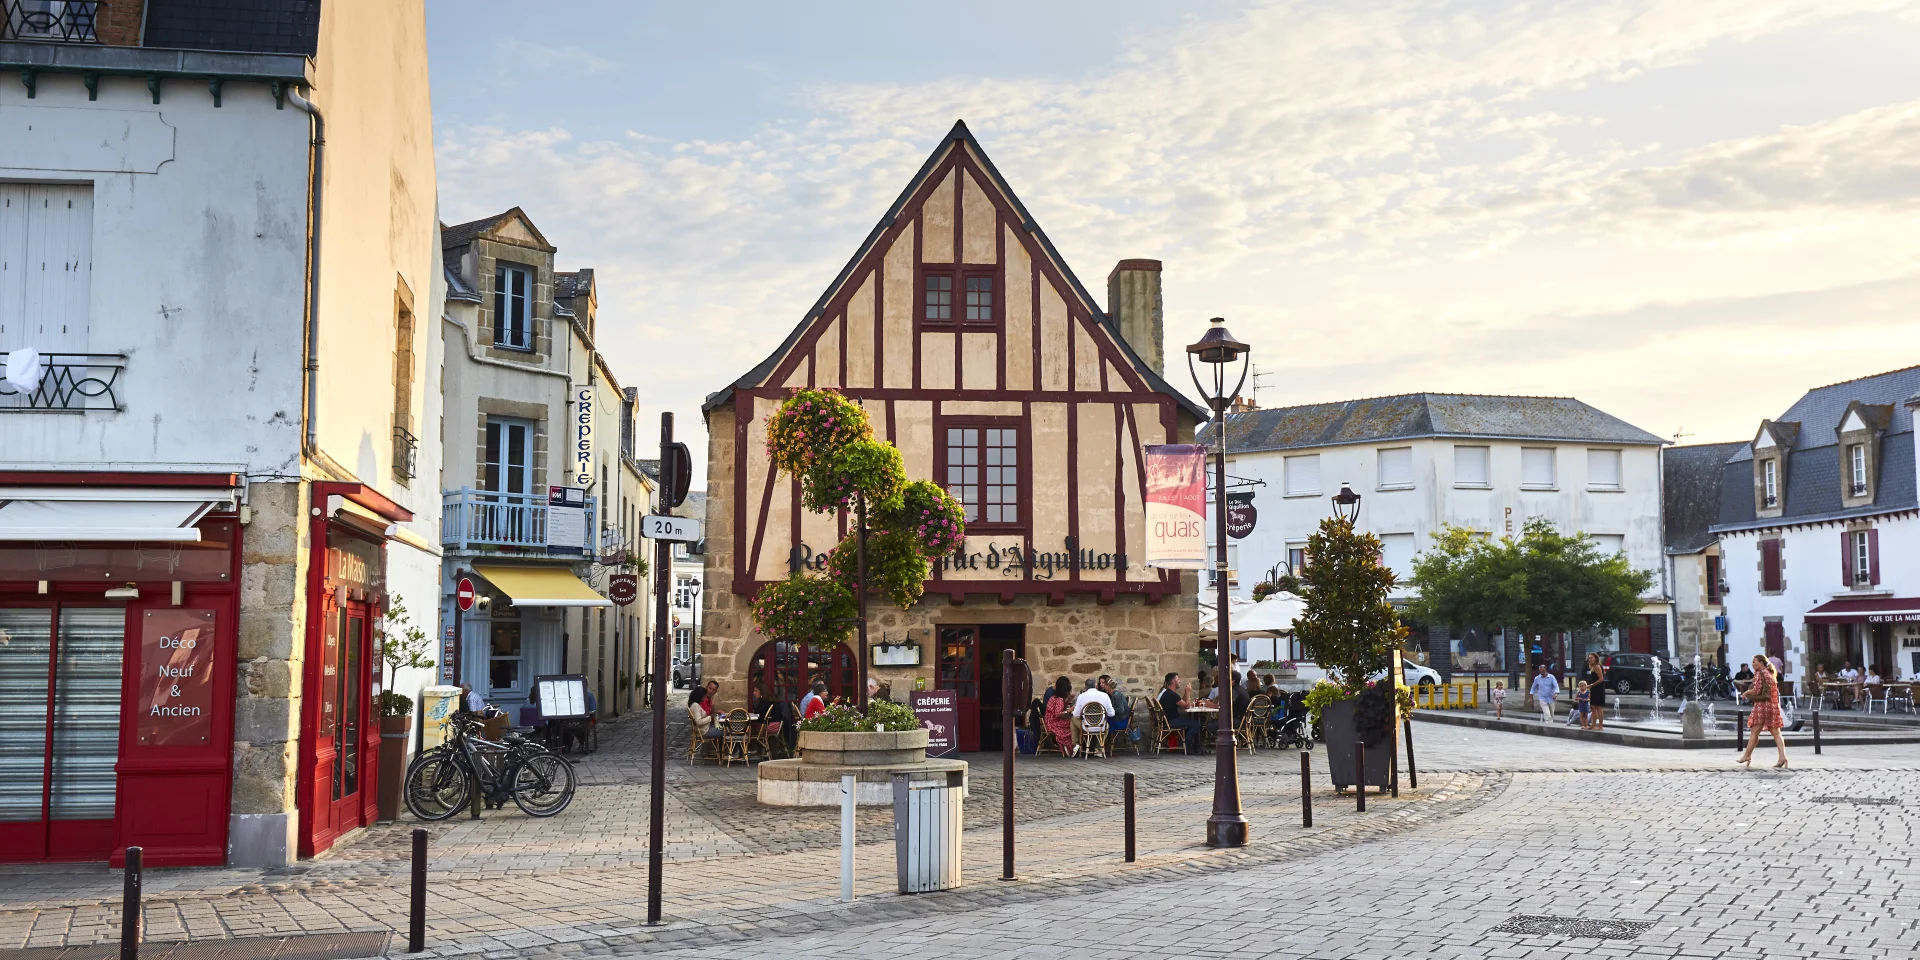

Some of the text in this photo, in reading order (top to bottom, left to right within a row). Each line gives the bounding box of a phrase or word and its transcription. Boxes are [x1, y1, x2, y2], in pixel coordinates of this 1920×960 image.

[655, 521, 672, 534] 20
[1155, 514, 1200, 544] quais
[338, 549, 347, 580] La
[347, 552, 369, 585] Maison
[159, 636, 197, 649] Déco
[159, 664, 195, 678] Neuf
[170, 684, 181, 697] &
[917, 697, 951, 706] CRÊPERIE
[150, 703, 201, 716] Ancien
